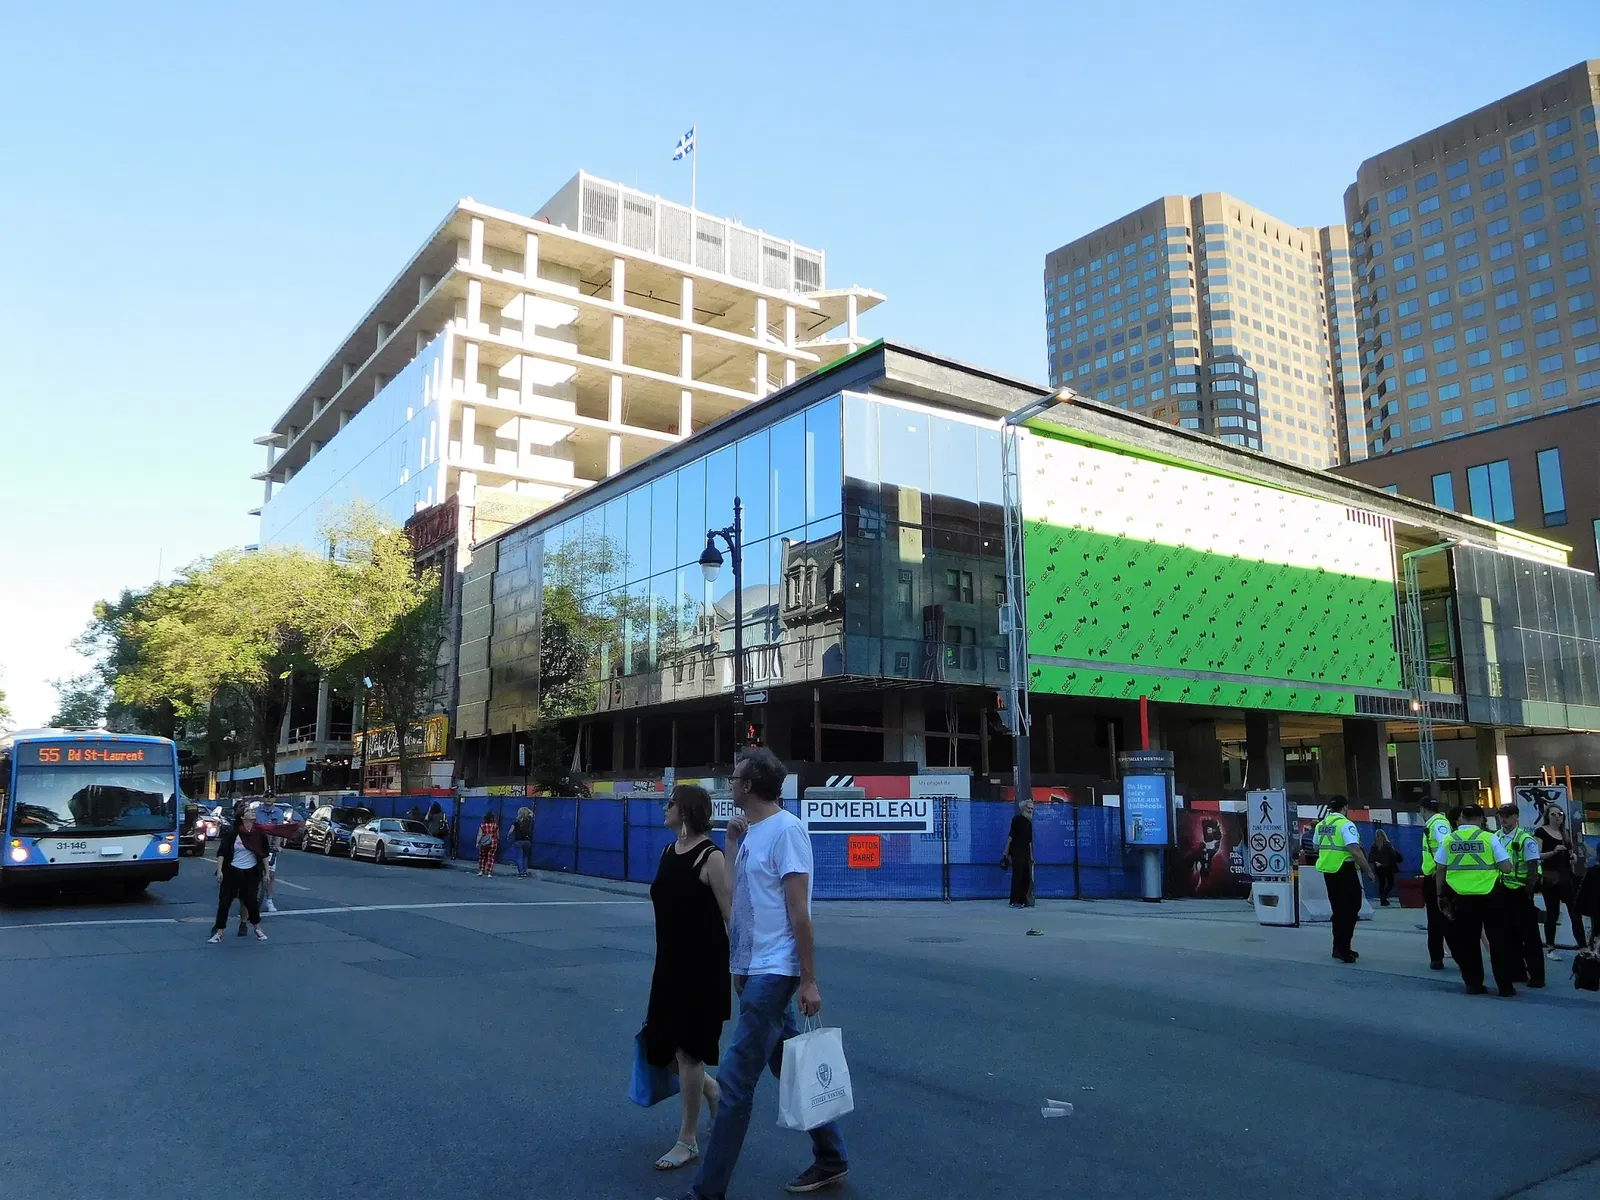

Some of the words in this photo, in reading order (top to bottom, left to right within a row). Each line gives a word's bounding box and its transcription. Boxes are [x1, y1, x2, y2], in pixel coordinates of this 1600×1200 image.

[1062, 680, 1070, 691] CGC
[1089, 683, 1097, 694] CGC
[39, 748, 60, 762] 55
[68, 749, 81, 761] Bd
[84, 749, 144, 761] St-Laurent
[713, 802, 744, 816] MERL
[808, 802, 926, 817] POMERLEAU
[1451, 843, 1483, 852] CADET
[853, 852, 875, 862] BARRÉ
